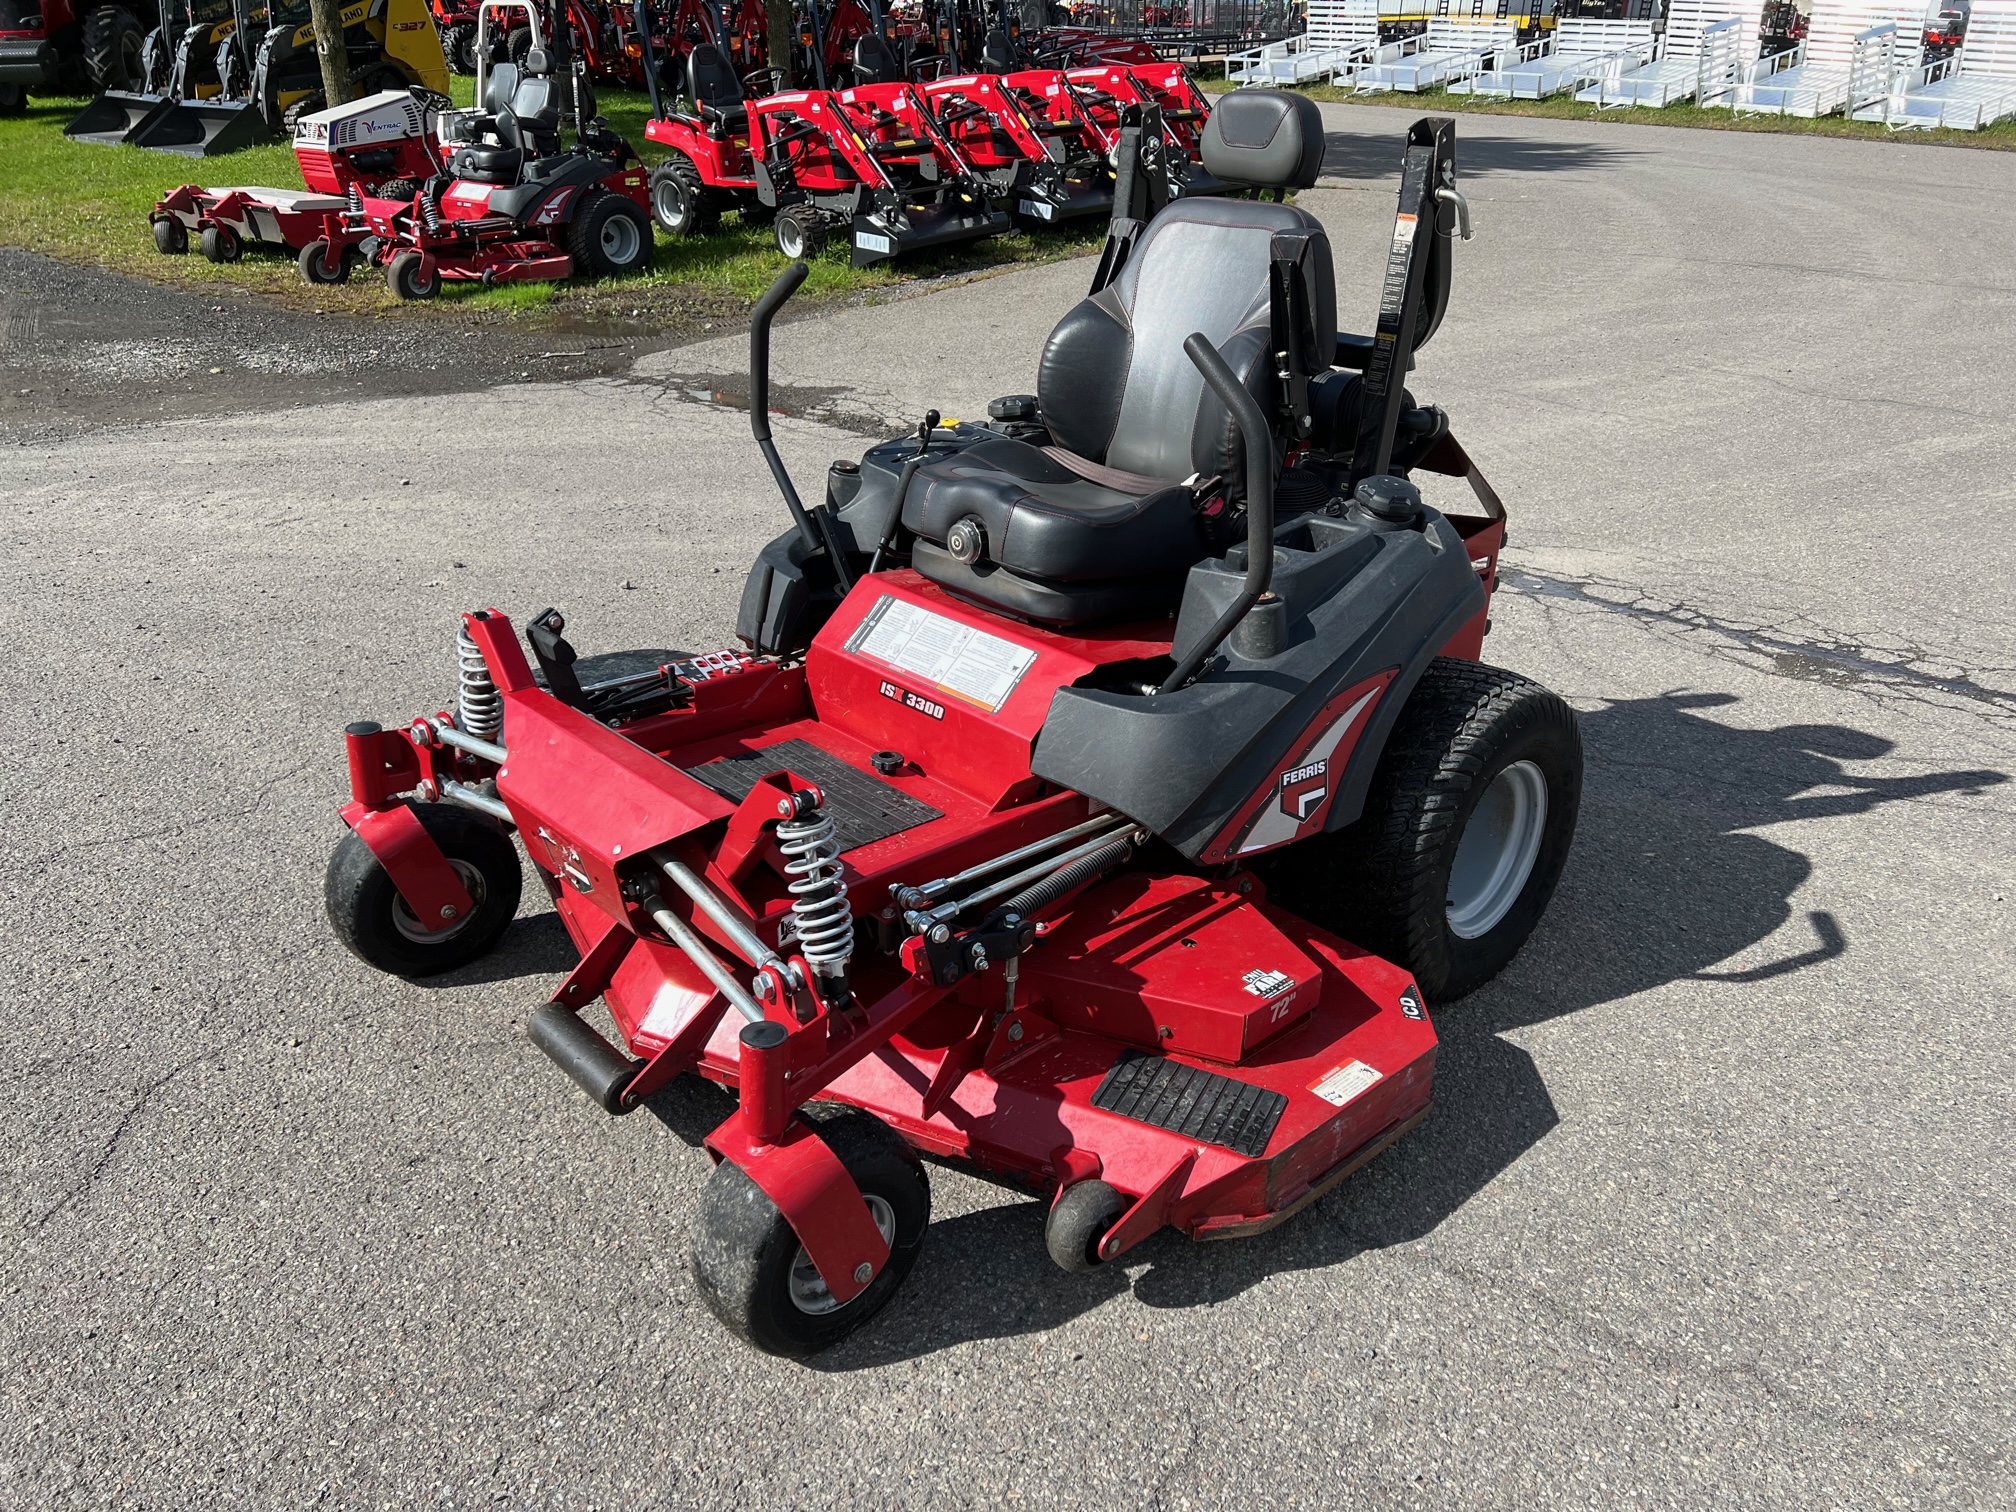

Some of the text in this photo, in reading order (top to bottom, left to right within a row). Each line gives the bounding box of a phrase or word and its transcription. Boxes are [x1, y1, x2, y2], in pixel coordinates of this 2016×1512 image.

[880, 681, 904, 702] ISX
[906, 693, 944, 719] 3300
[1283, 761, 1326, 786] FERRIS
[1270, 991, 1297, 1024] 72"
